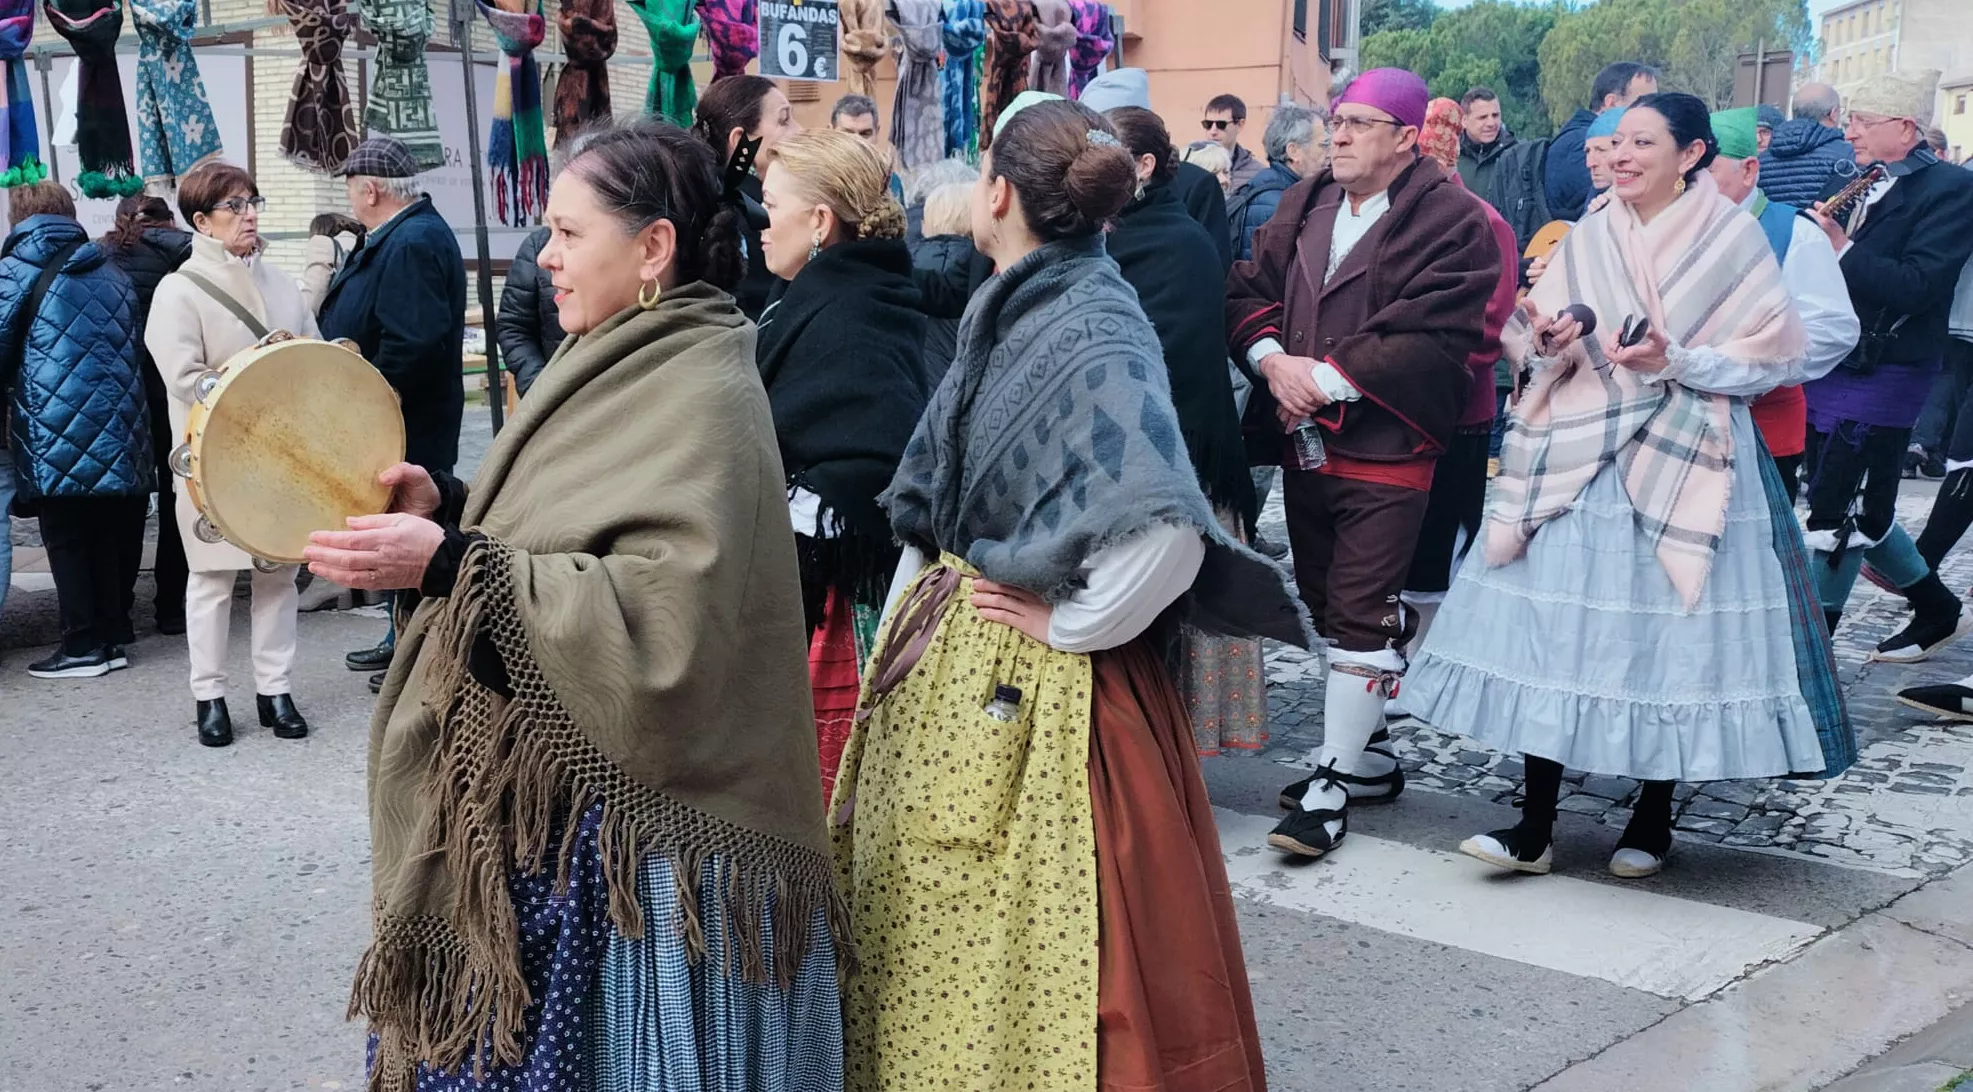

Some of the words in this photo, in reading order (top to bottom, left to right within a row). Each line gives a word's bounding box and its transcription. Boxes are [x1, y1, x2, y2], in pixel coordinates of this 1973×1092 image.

[761, 2, 837, 24] BUFANDAS
[778, 23, 808, 76] 6
[813, 57, 827, 78] €
